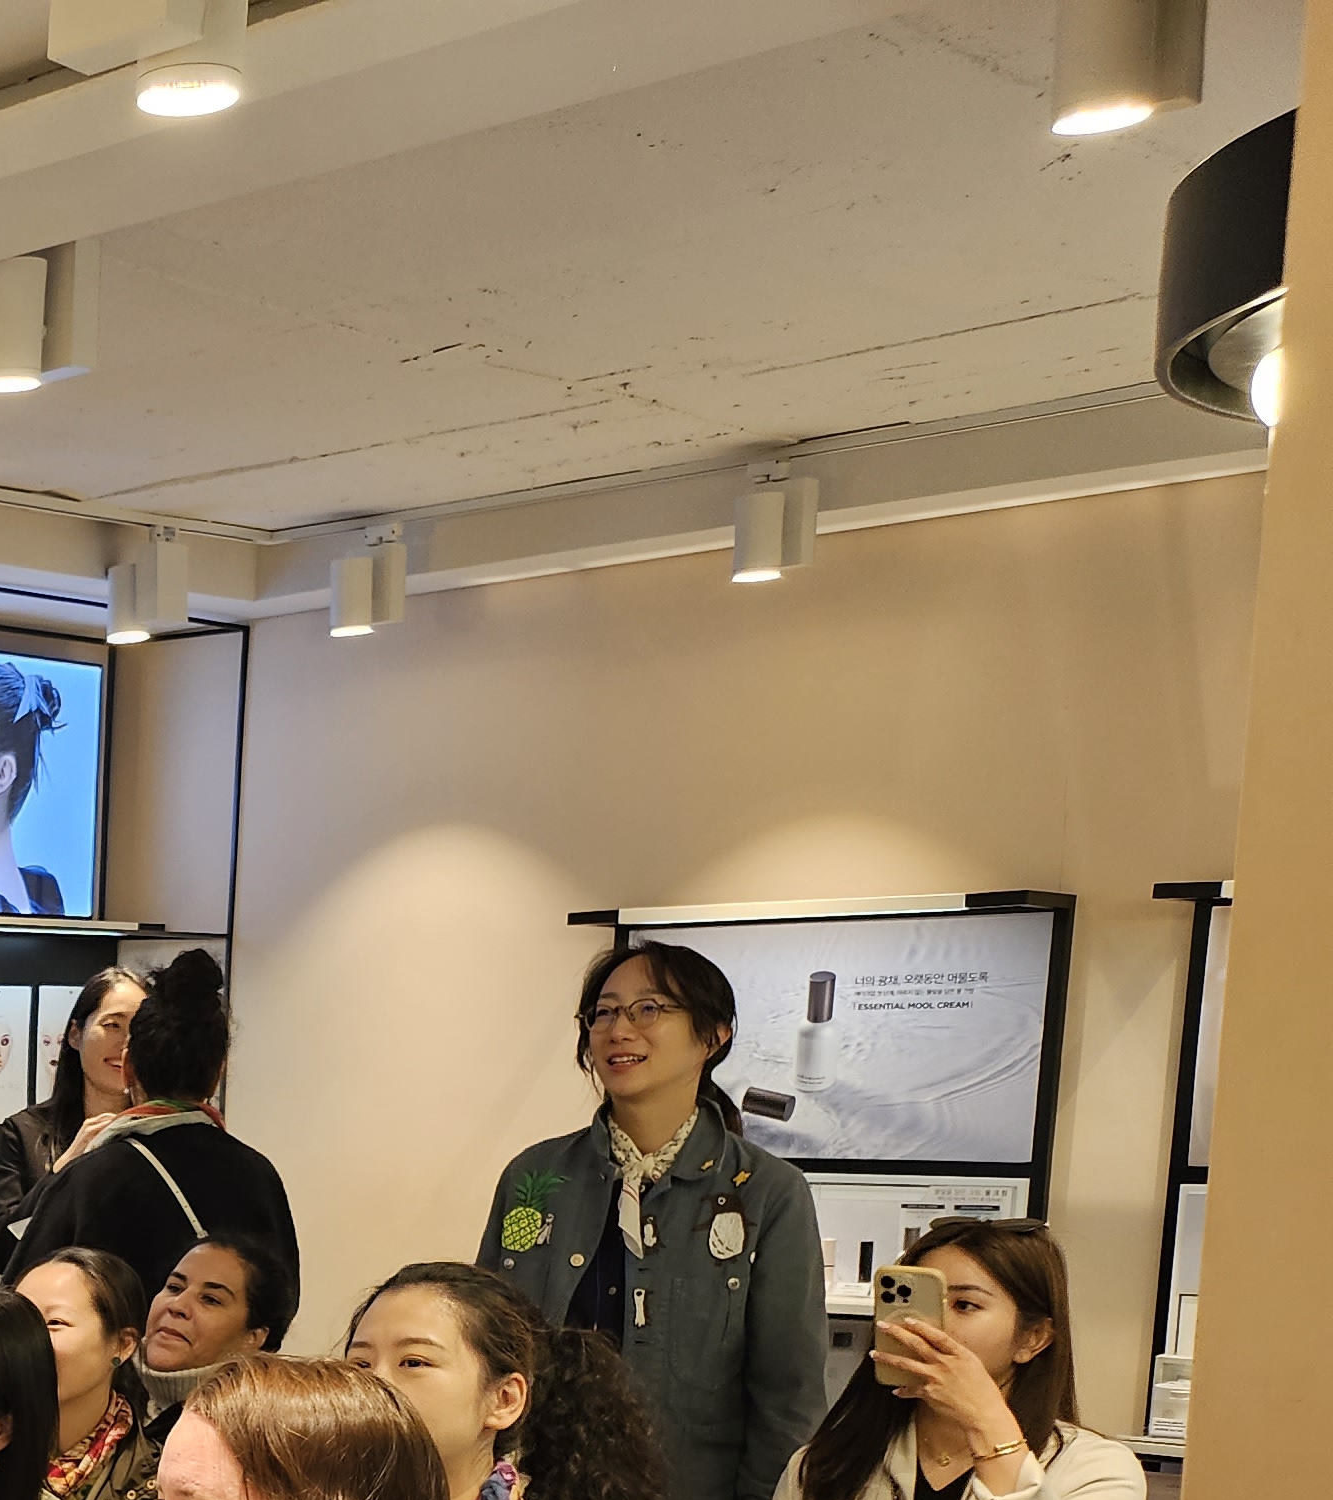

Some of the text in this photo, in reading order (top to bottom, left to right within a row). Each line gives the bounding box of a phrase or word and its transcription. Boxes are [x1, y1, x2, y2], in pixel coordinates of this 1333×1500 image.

[857, 1001, 970, 1011] ESSENTIAL MOOL CREAM
